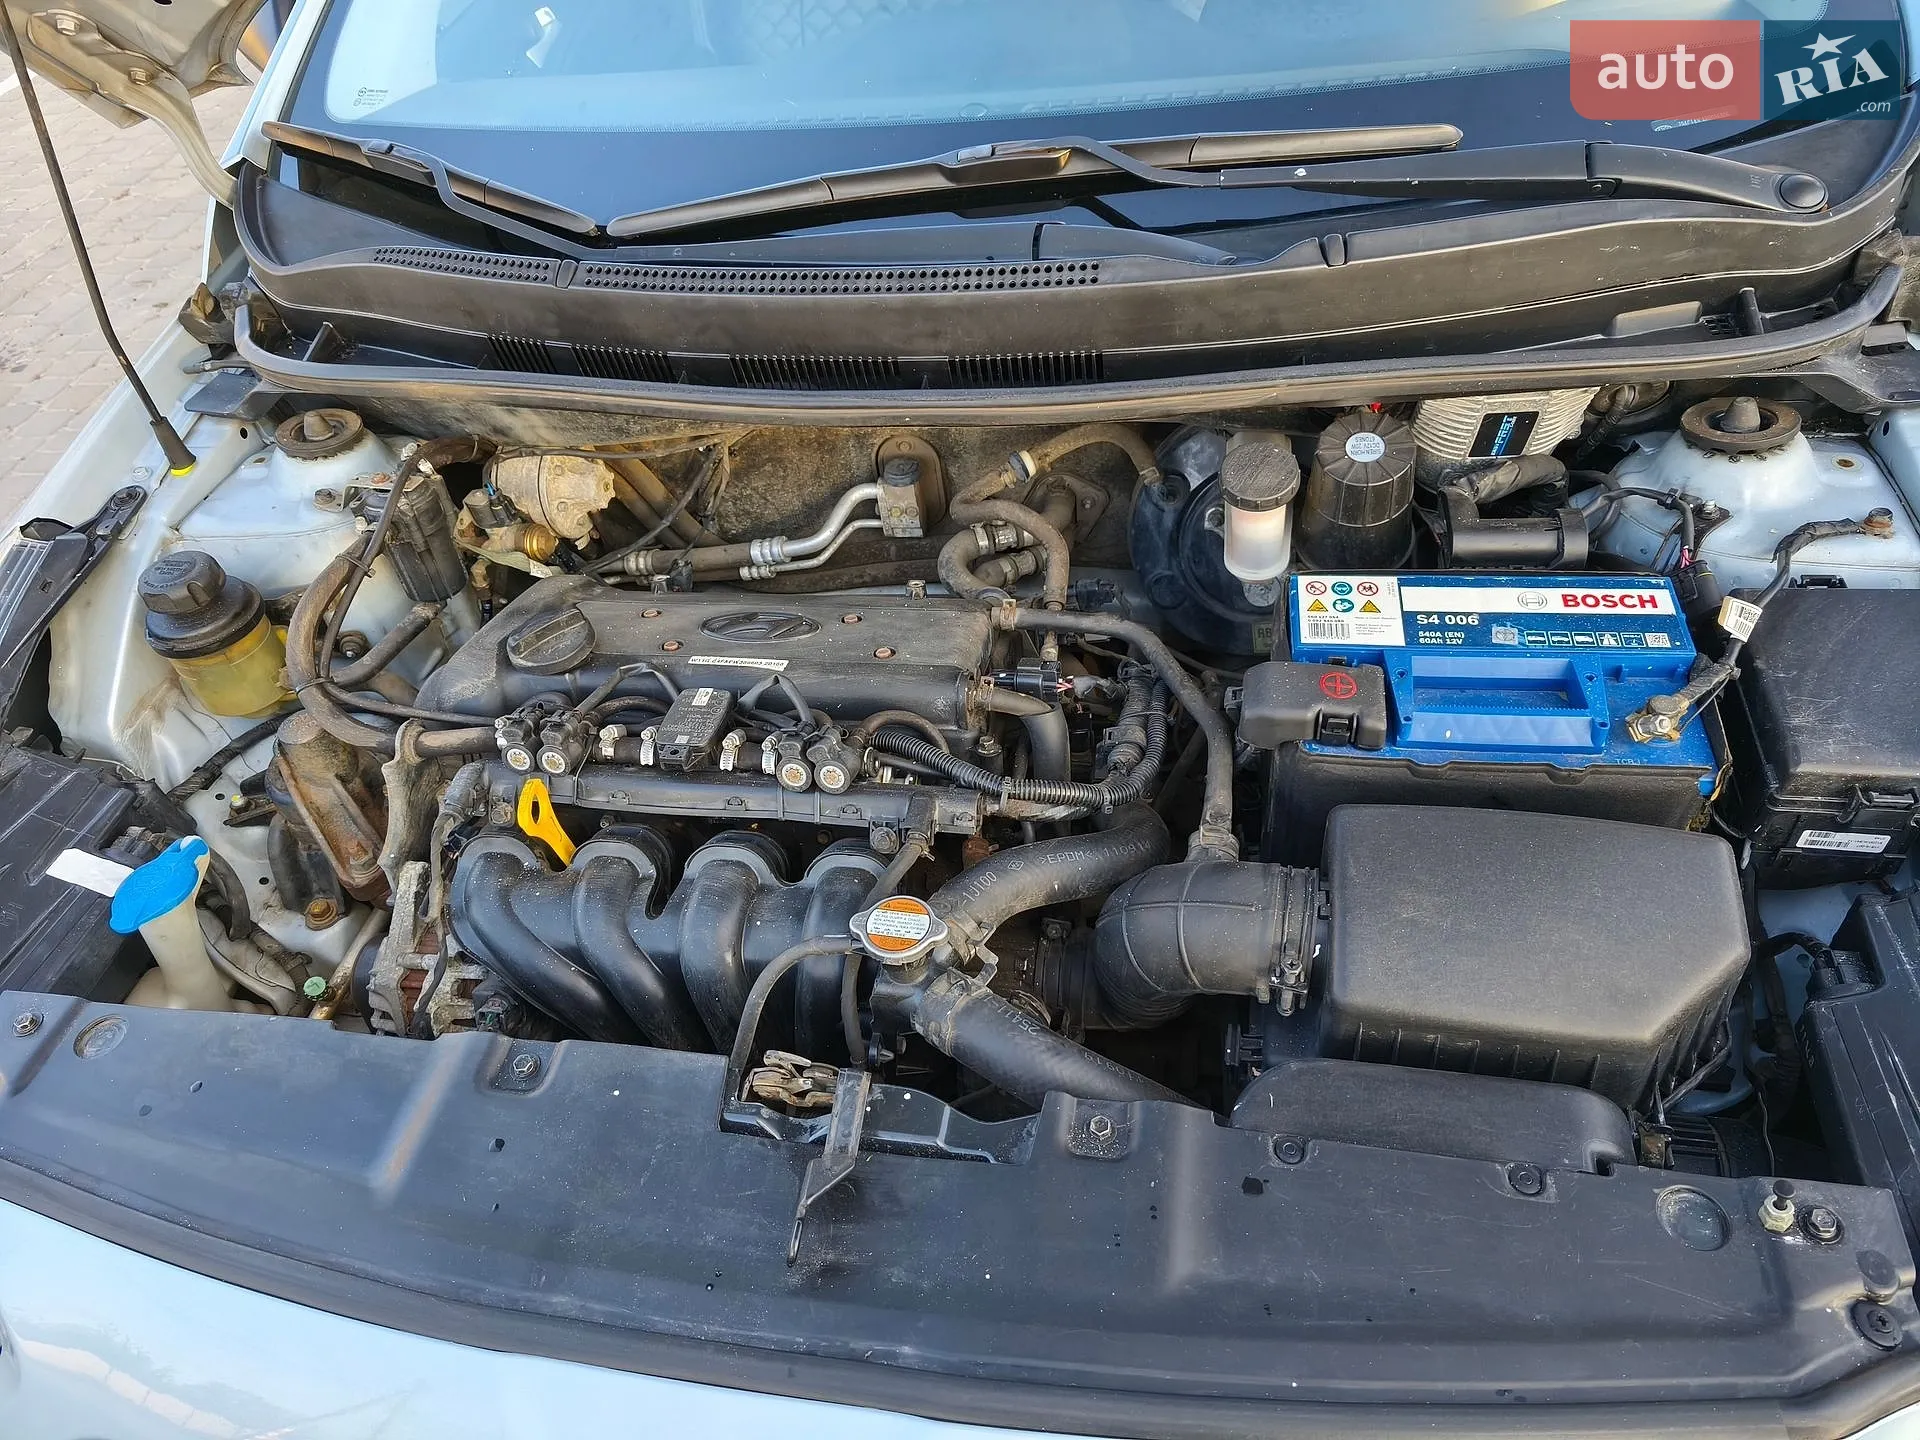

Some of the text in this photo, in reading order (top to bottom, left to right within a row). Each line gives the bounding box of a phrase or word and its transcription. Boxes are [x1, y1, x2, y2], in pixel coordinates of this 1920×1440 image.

[1562, 594, 1658, 608] BOSCH
[1416, 614, 1479, 625] S4 006
